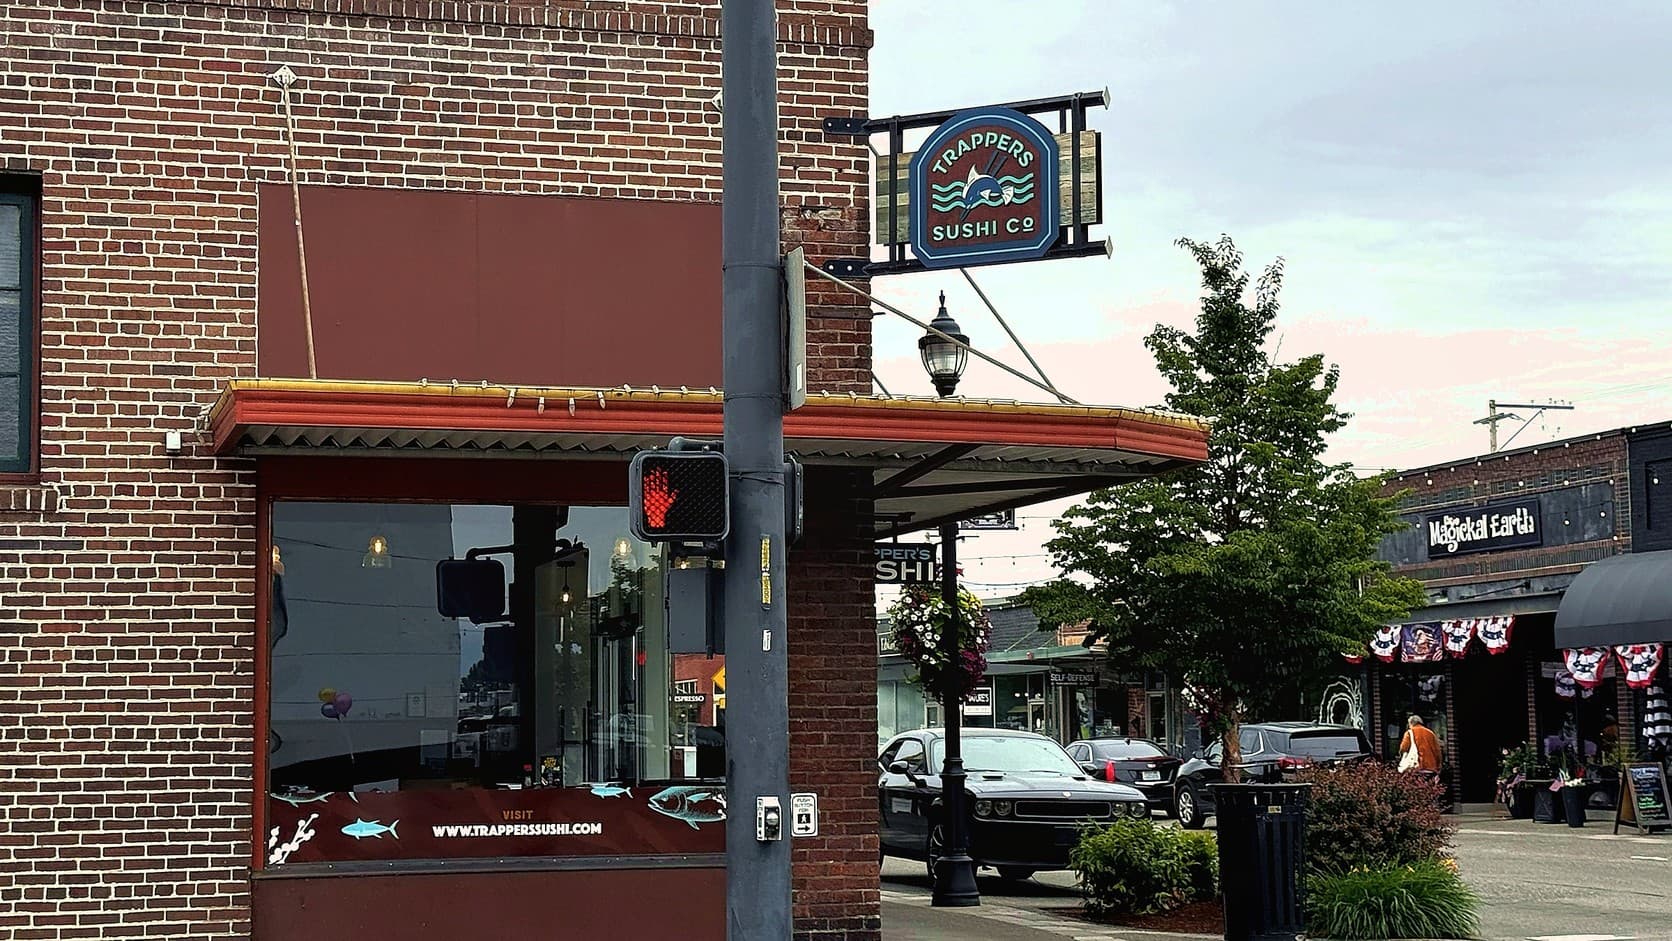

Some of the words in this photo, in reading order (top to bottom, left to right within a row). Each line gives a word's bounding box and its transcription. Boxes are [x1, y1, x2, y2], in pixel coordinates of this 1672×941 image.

[932, 132, 1034, 174] TRAPPERS
[932, 220, 997, 241] SUSHI
[1429, 514, 1488, 552] Magickal
[1490, 507, 1534, 535] Earth
[502, 810, 534, 820] VISIT
[432, 823, 602, 838] WWW.TRAPPERSSUSHI.COM
